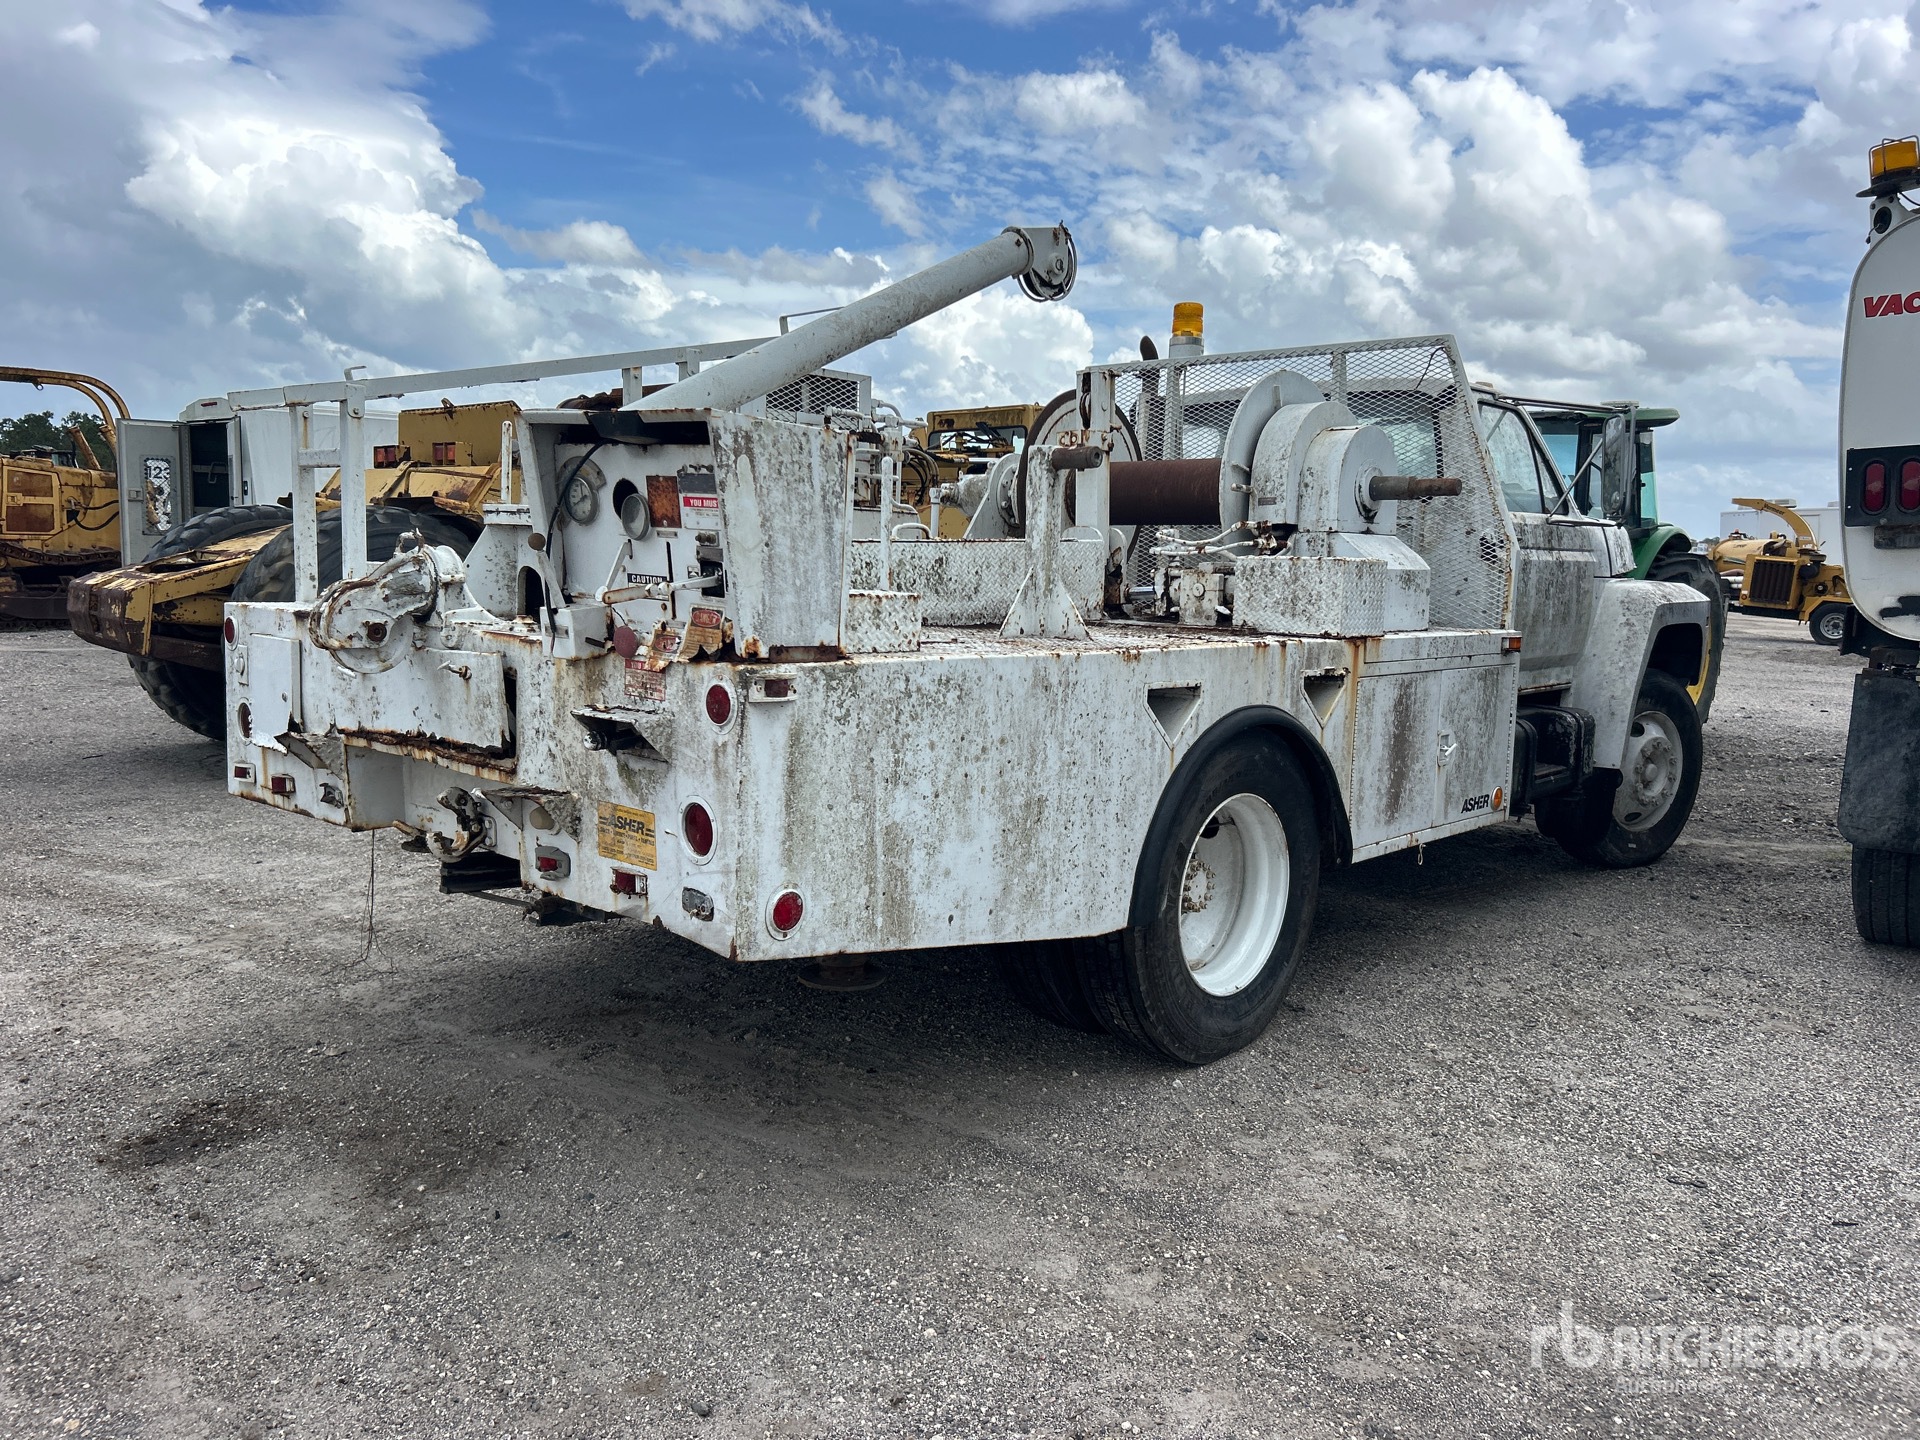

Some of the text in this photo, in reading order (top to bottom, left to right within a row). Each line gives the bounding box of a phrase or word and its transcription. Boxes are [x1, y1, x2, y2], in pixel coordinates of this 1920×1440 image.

[690, 498, 718, 508] YOU MUS
[1461, 794, 1490, 814] ASHER
[608, 815, 645, 835] ASHER
